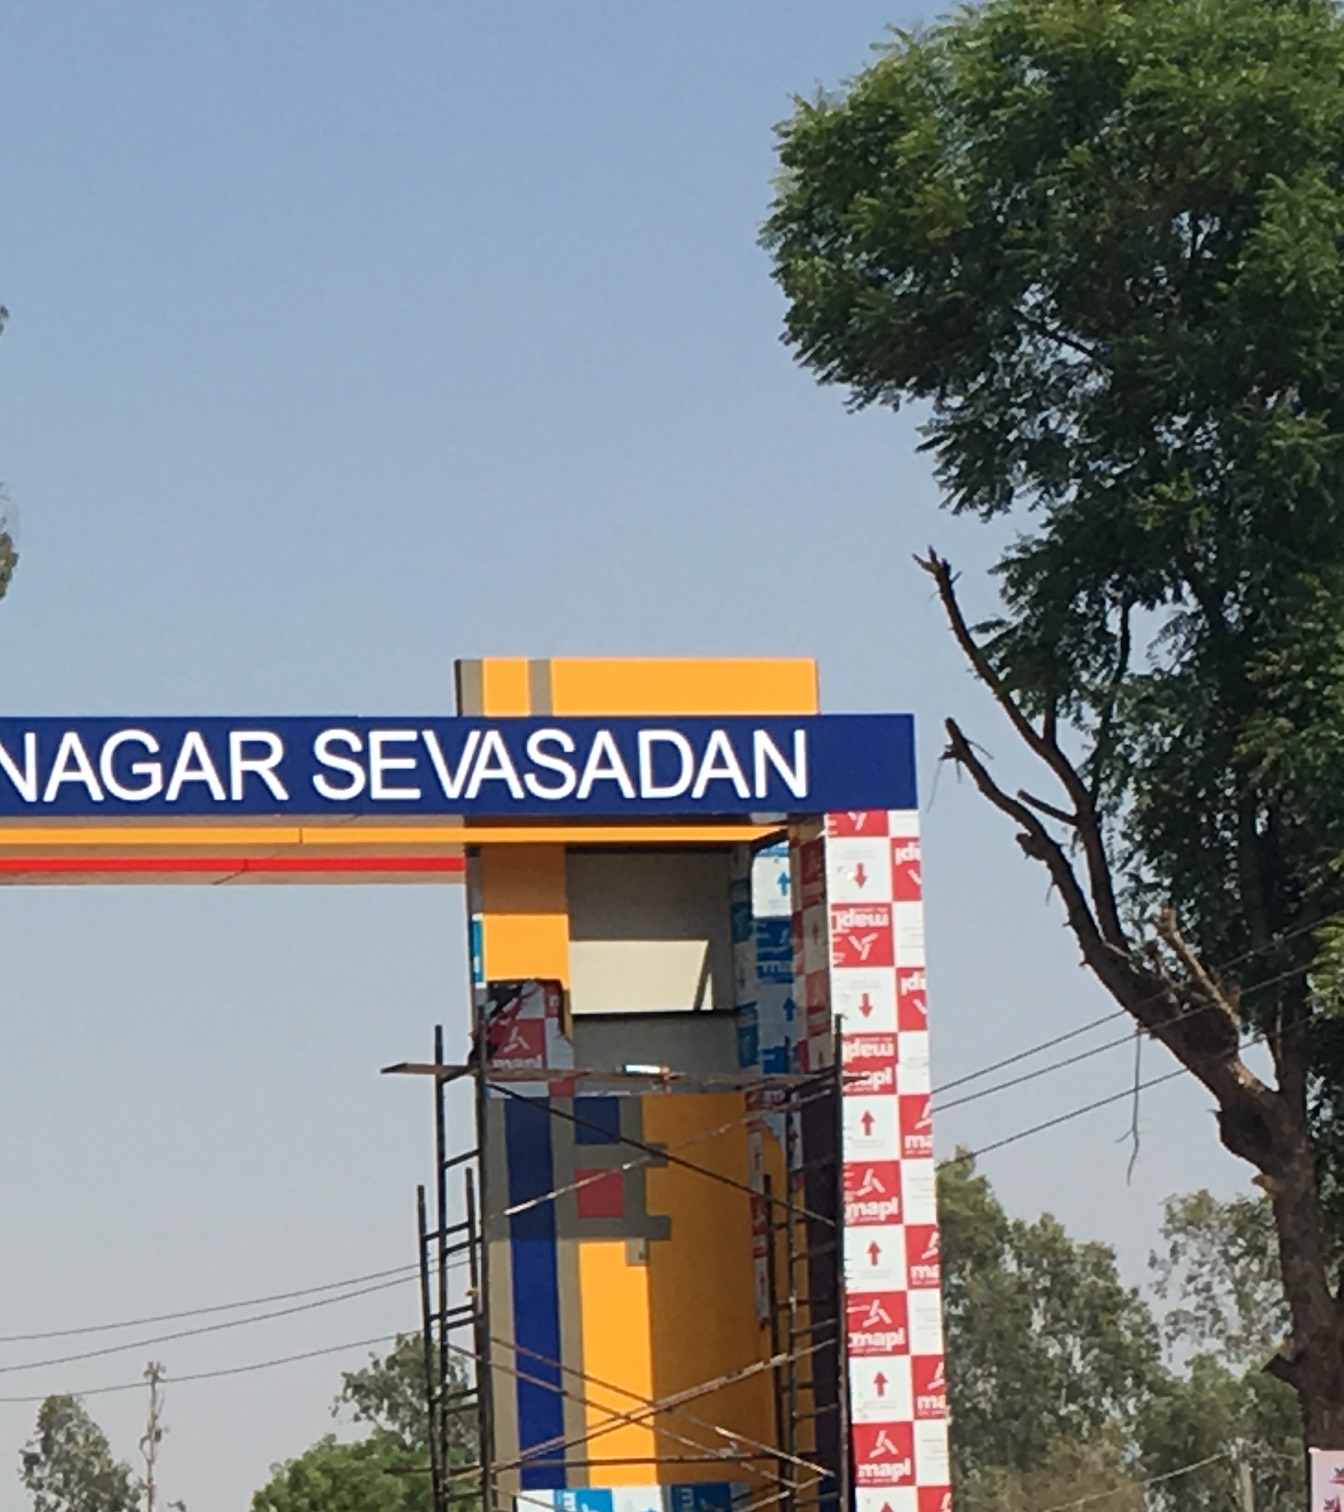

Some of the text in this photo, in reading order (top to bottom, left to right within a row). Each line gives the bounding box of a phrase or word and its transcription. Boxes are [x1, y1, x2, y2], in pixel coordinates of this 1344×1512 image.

[312, 728, 808, 800] SEVASADAN
[846, 1197, 899, 1221] mapl
[853, 1327, 906, 1351] mapl
[858, 1457, 912, 1482] mapl
